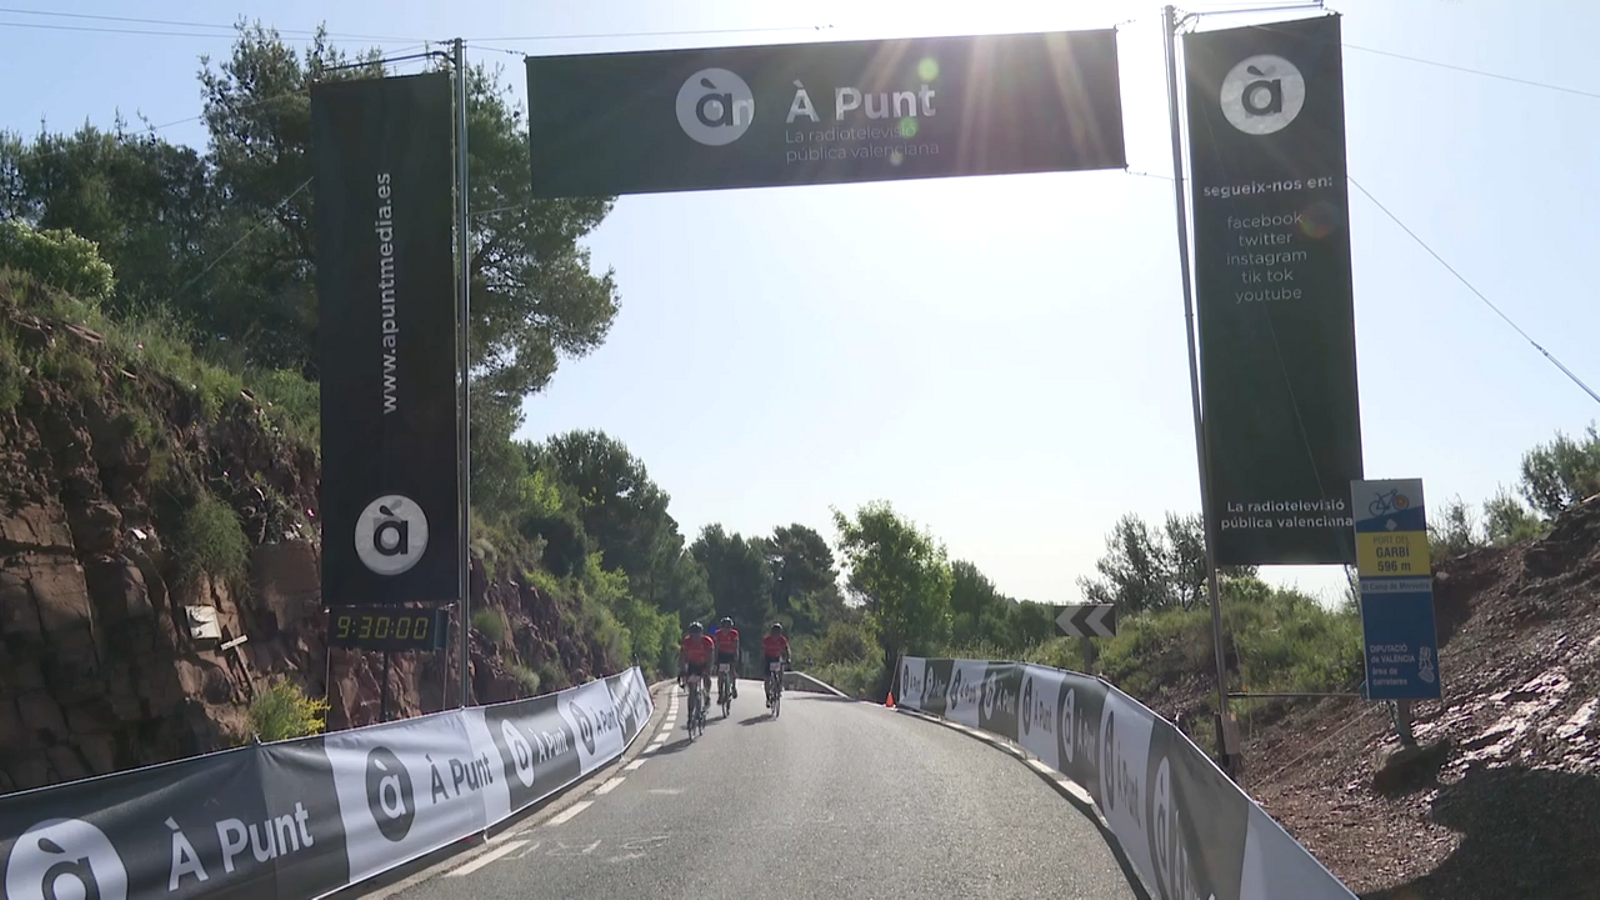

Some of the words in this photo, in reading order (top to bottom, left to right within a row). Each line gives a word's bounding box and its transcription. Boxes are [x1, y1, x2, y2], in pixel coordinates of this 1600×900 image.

[785, 80, 820, 123] À
[835, 84, 936, 121] Punt
[785, 129, 804, 144] La
[808, 123, 917, 143] radiotelevisió
[786, 145, 847, 165] pública
[850, 142, 940, 160] valenciana
[1203, 178, 1303, 198] segueix-nos
[1307, 176, 1333, 189] en:
[1227, 212, 1303, 230] facebook
[1238, 231, 1293, 247] twitter
[1226, 250, 1307, 267] instagram
[1241, 270, 1262, 284] tik
[1267, 268, 1294, 282] tok
[375, 172, 399, 415] www.apuntmedia.es
[1235, 287, 1302, 304] youtube
[1227, 502, 1243, 513] La
[1248, 499, 1345, 513] radiotelevisió
[1221, 514, 1273, 530] pública
[1278, 515, 1354, 528] valenciana
[1396, 534, 1410, 545] DEL
[1377, 560, 1398, 572] 596
[1401, 562, 1411, 571] m
[337, 616, 430, 640] 9:30:00
[1369, 643, 1408, 653] DIPUTACIÓ
[1389, 667, 1398, 675] de
[528, 727, 547, 763] À
[542, 726, 569, 759] Punt
[425, 754, 450, 804] À
[451, 753, 494, 796] Punt
[164, 816, 209, 892] À
[215, 802, 315, 874] Punt
